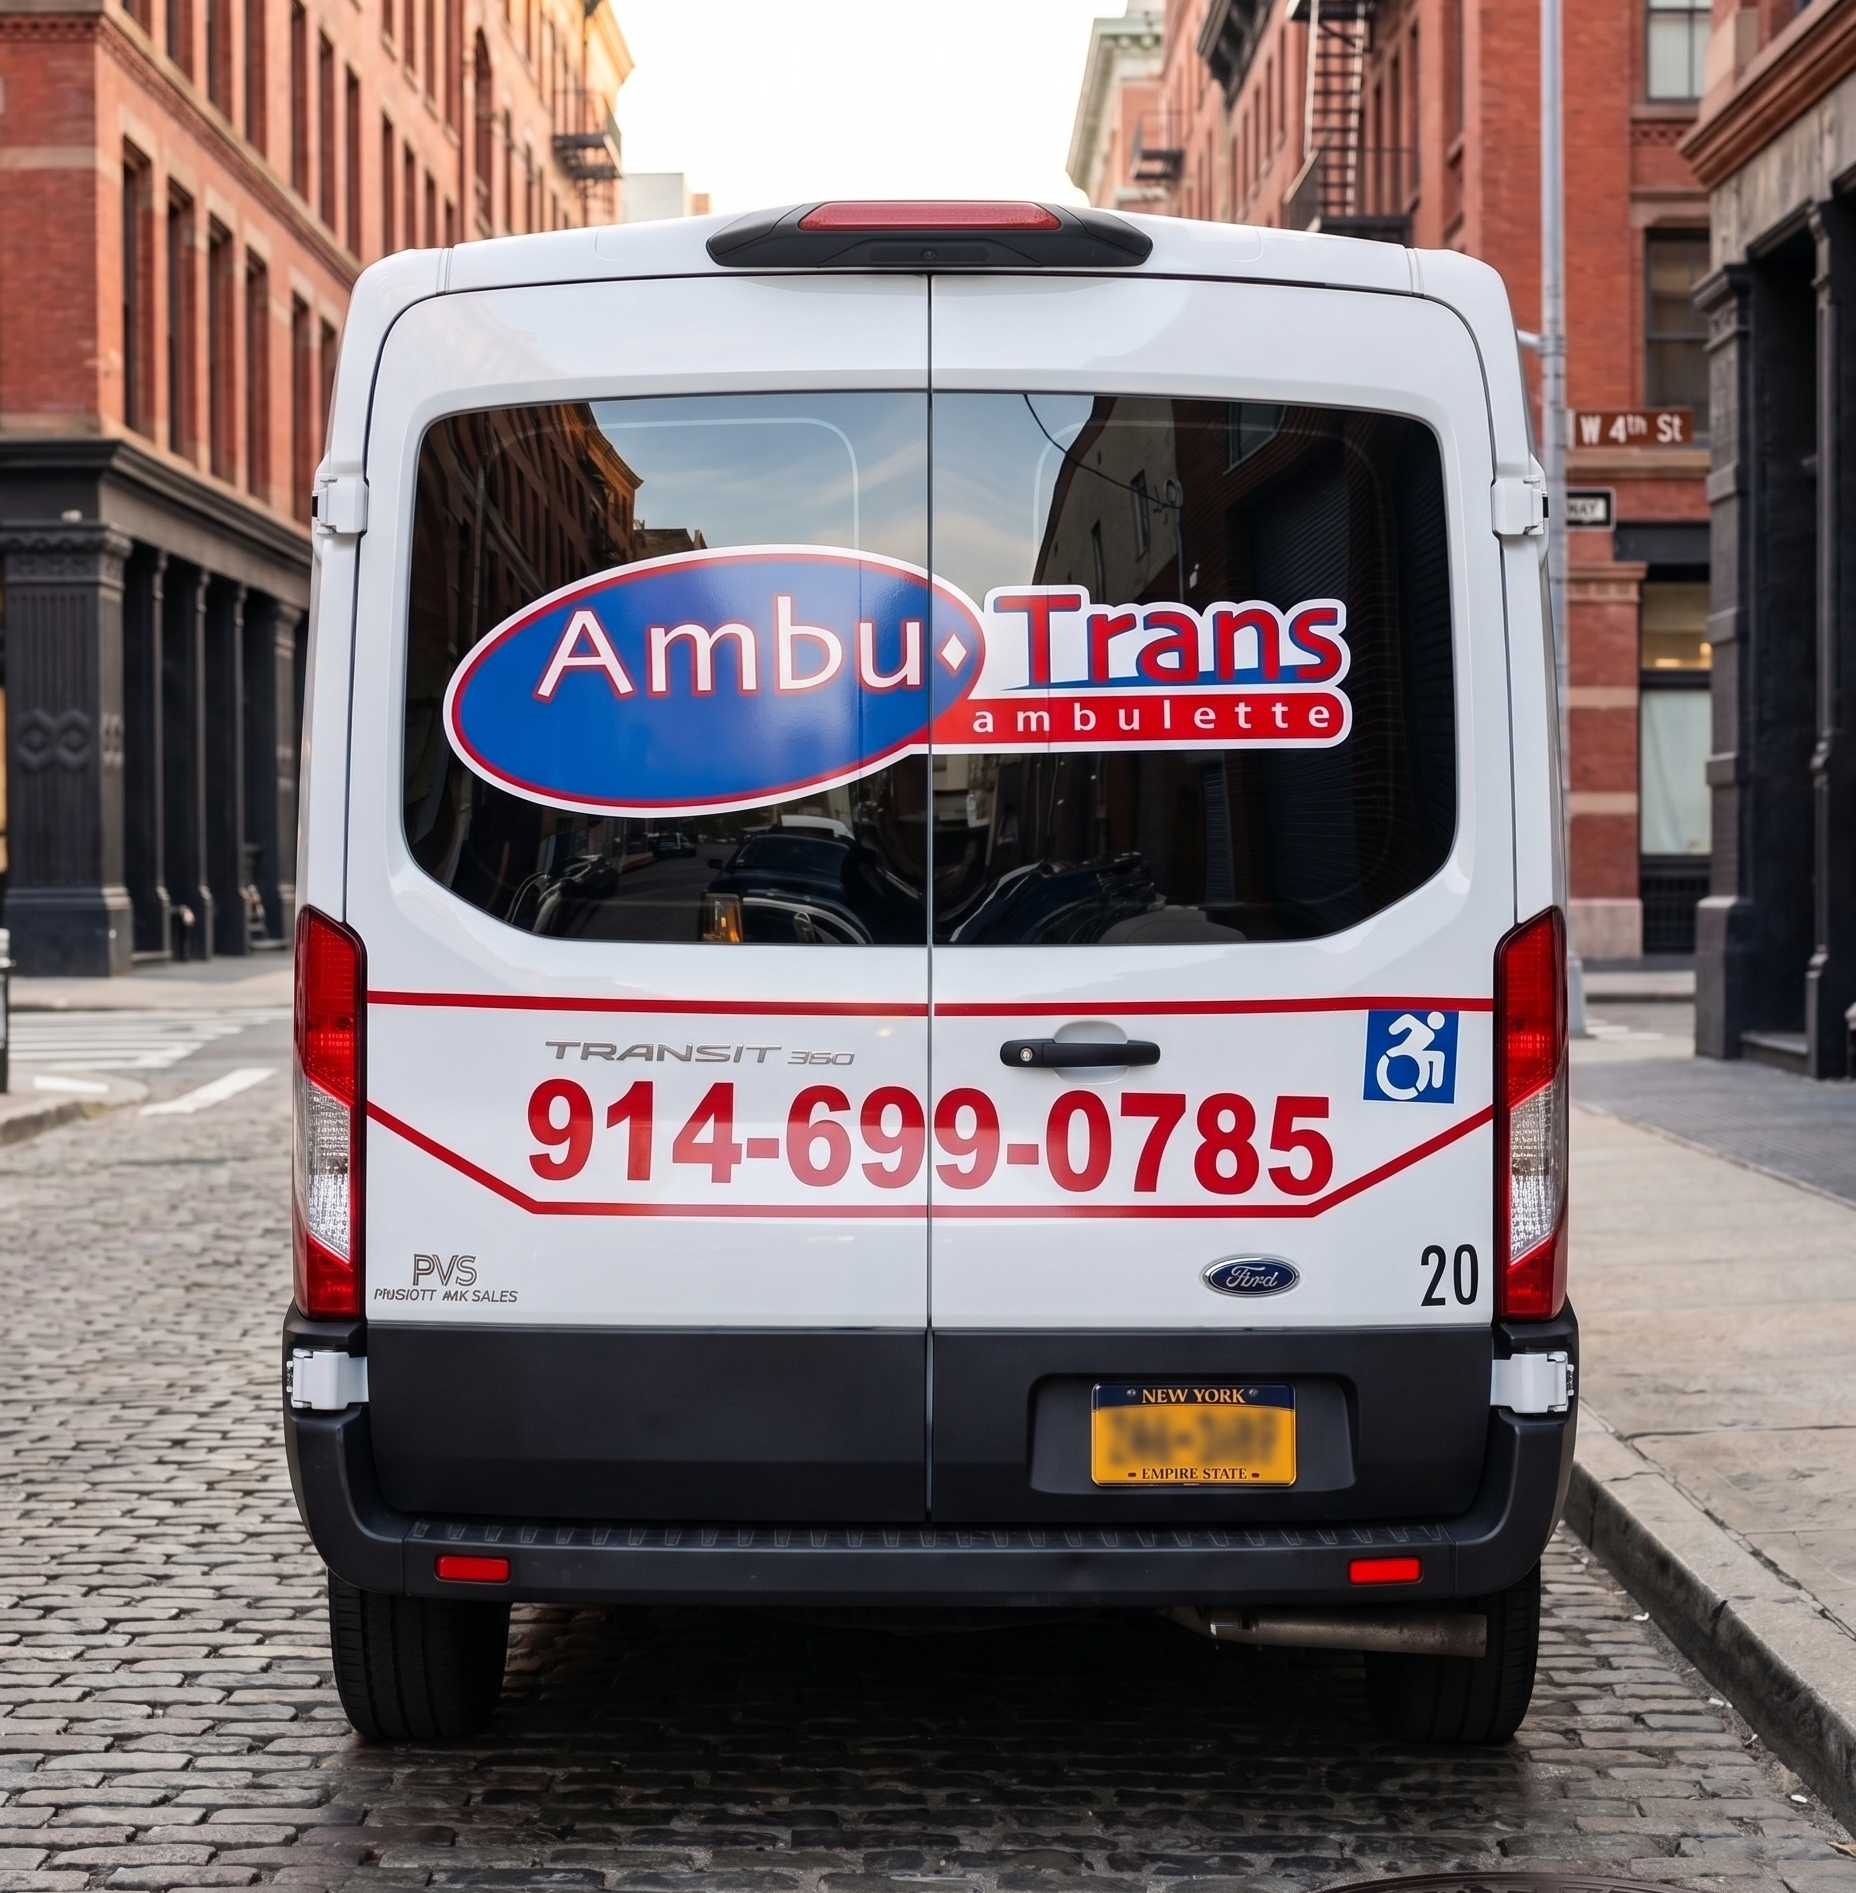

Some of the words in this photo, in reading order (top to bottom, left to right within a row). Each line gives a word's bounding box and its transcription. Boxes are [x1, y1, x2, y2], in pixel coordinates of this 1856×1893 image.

[1580, 415, 1601, 444] W
[1609, 414, 1647, 443] 4th
[1656, 413, 1682, 443] St
[536, 595, 921, 698] Ambu
[993, 594, 1341, 685] Trans
[972, 700, 1330, 733] ambulette
[545, 1040, 782, 1064] TRANSIT
[527, 1078, 1333, 1196] 914-699-0785
[412, 1253, 478, 1287] PVS
[1226, 1265, 1278, 1288] Ford
[1420, 1243, 1479, 1307] 20
[471, 1289, 519, 1303] SALES
[1141, 1388, 1189, 1404] NEW
[1192, 1388, 1246, 1404] YORK
[1141, 1467, 1199, 1480] EMPIRE
[1202, 1467, 1248, 1480] STATE
